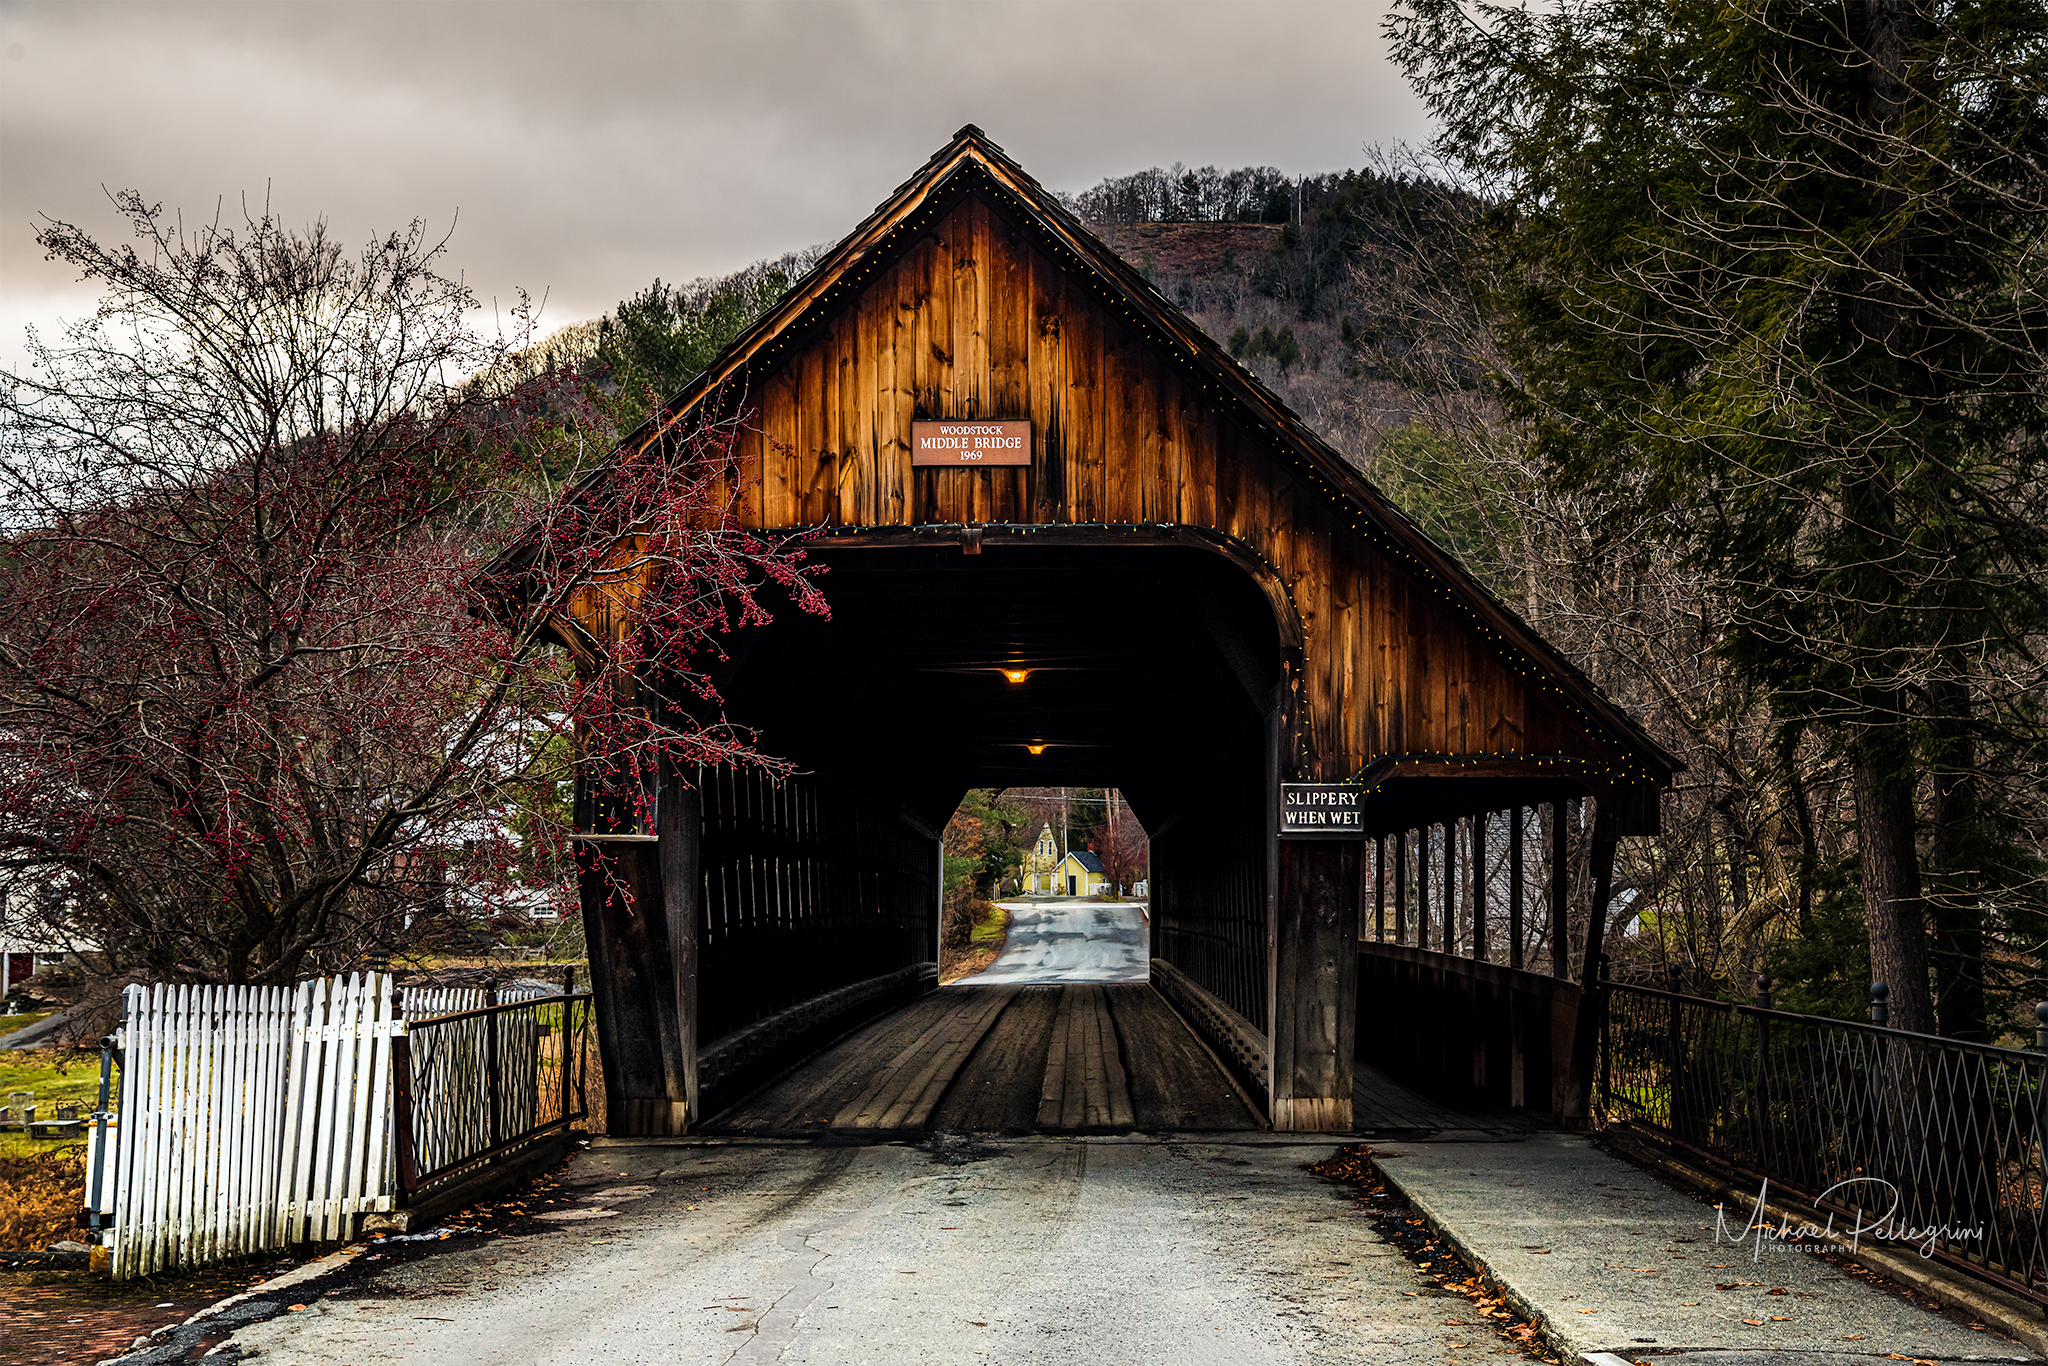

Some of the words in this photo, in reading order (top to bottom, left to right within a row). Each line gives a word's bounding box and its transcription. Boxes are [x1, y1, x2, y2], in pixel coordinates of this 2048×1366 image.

[940, 426, 1003, 435] WOODSTOCK
[920, 437, 969, 449] MIDDLE
[974, 437, 1022, 449] BRIDGE
[960, 450, 983, 460] 1969
[1286, 792, 1359, 805] SLIPPERY
[1285, 811, 1326, 824] WHEN
[1330, 811, 1361, 824] WET
